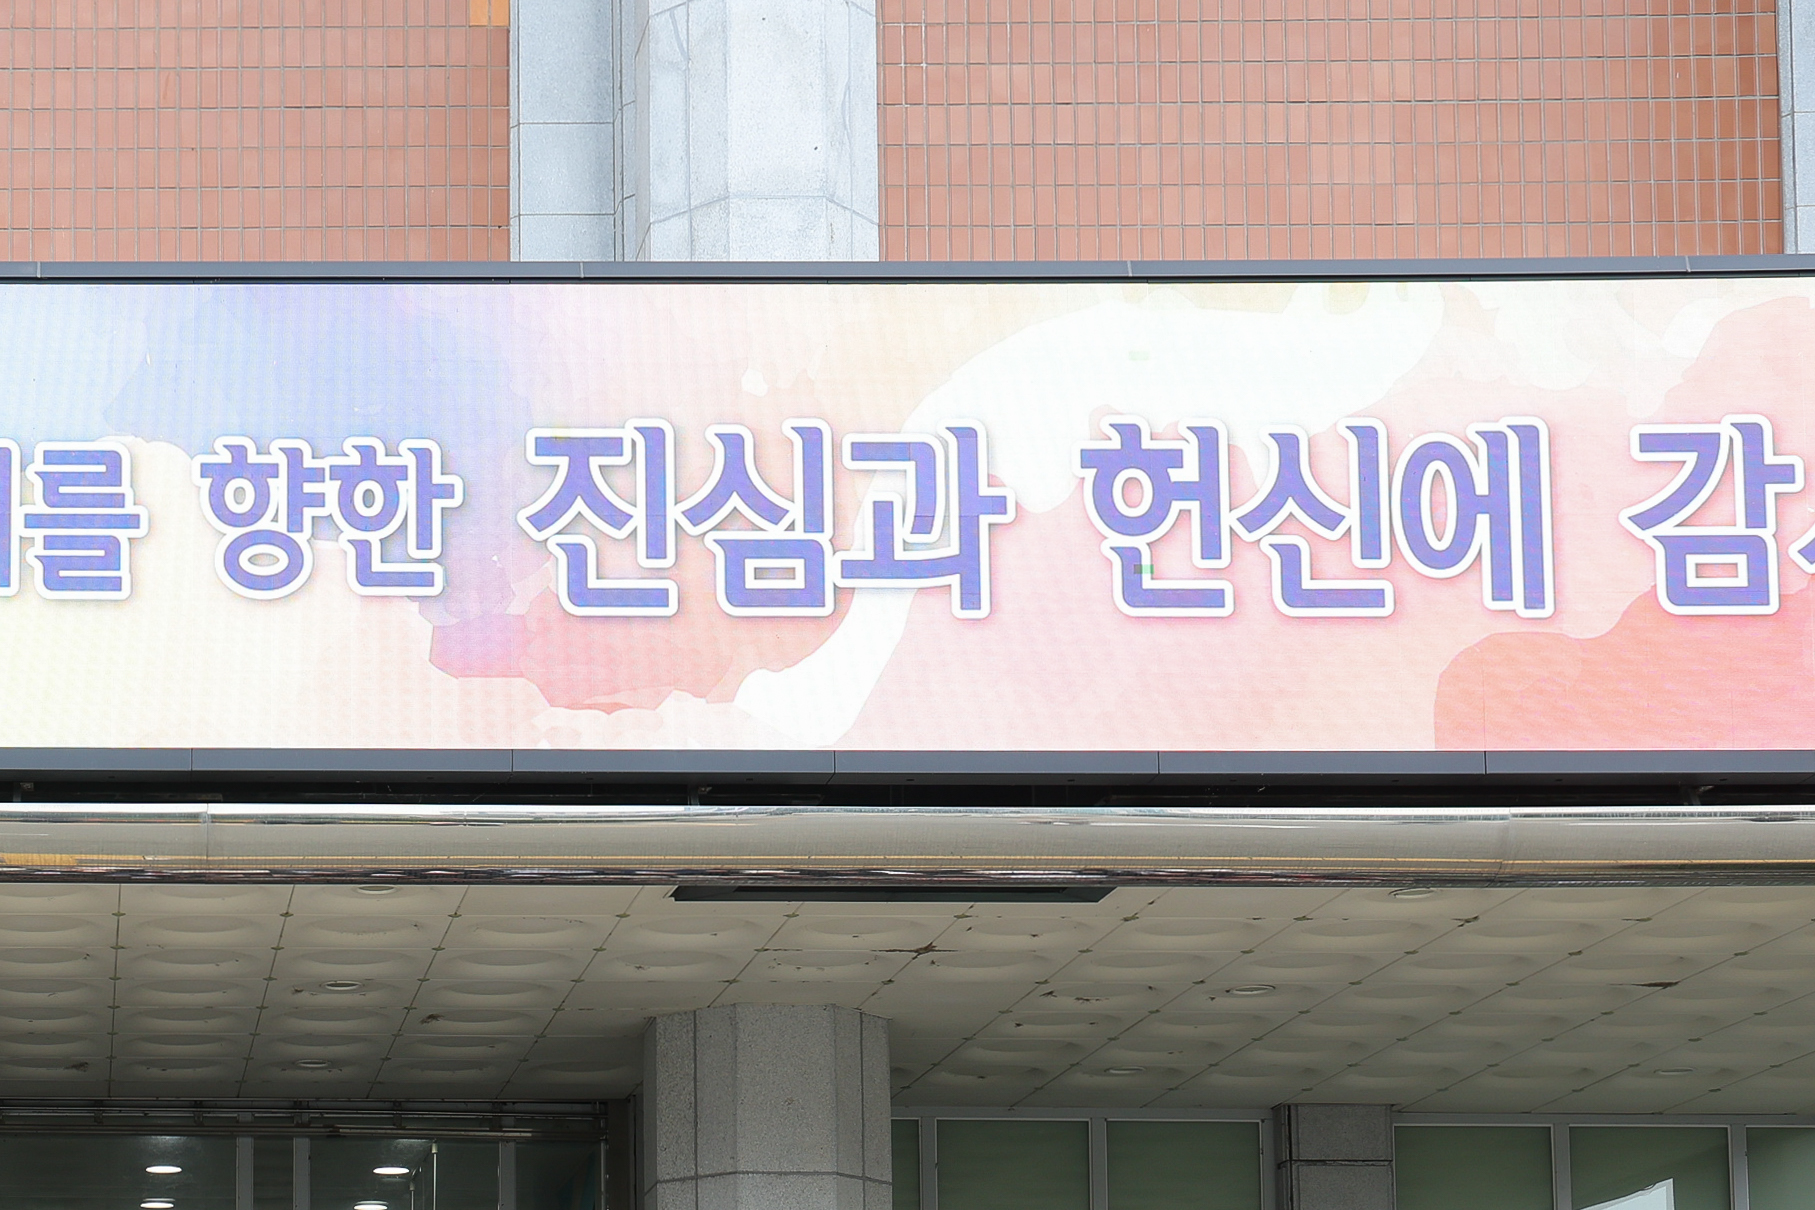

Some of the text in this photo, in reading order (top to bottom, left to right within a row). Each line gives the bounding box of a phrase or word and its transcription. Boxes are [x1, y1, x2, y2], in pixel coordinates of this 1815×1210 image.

[196, 442, 461, 595] 향한
[521, 423, 1012, 613] 진심과
[1077, 421, 1548, 612] 헌신에
[1624, 420, 1815, 608] 감
